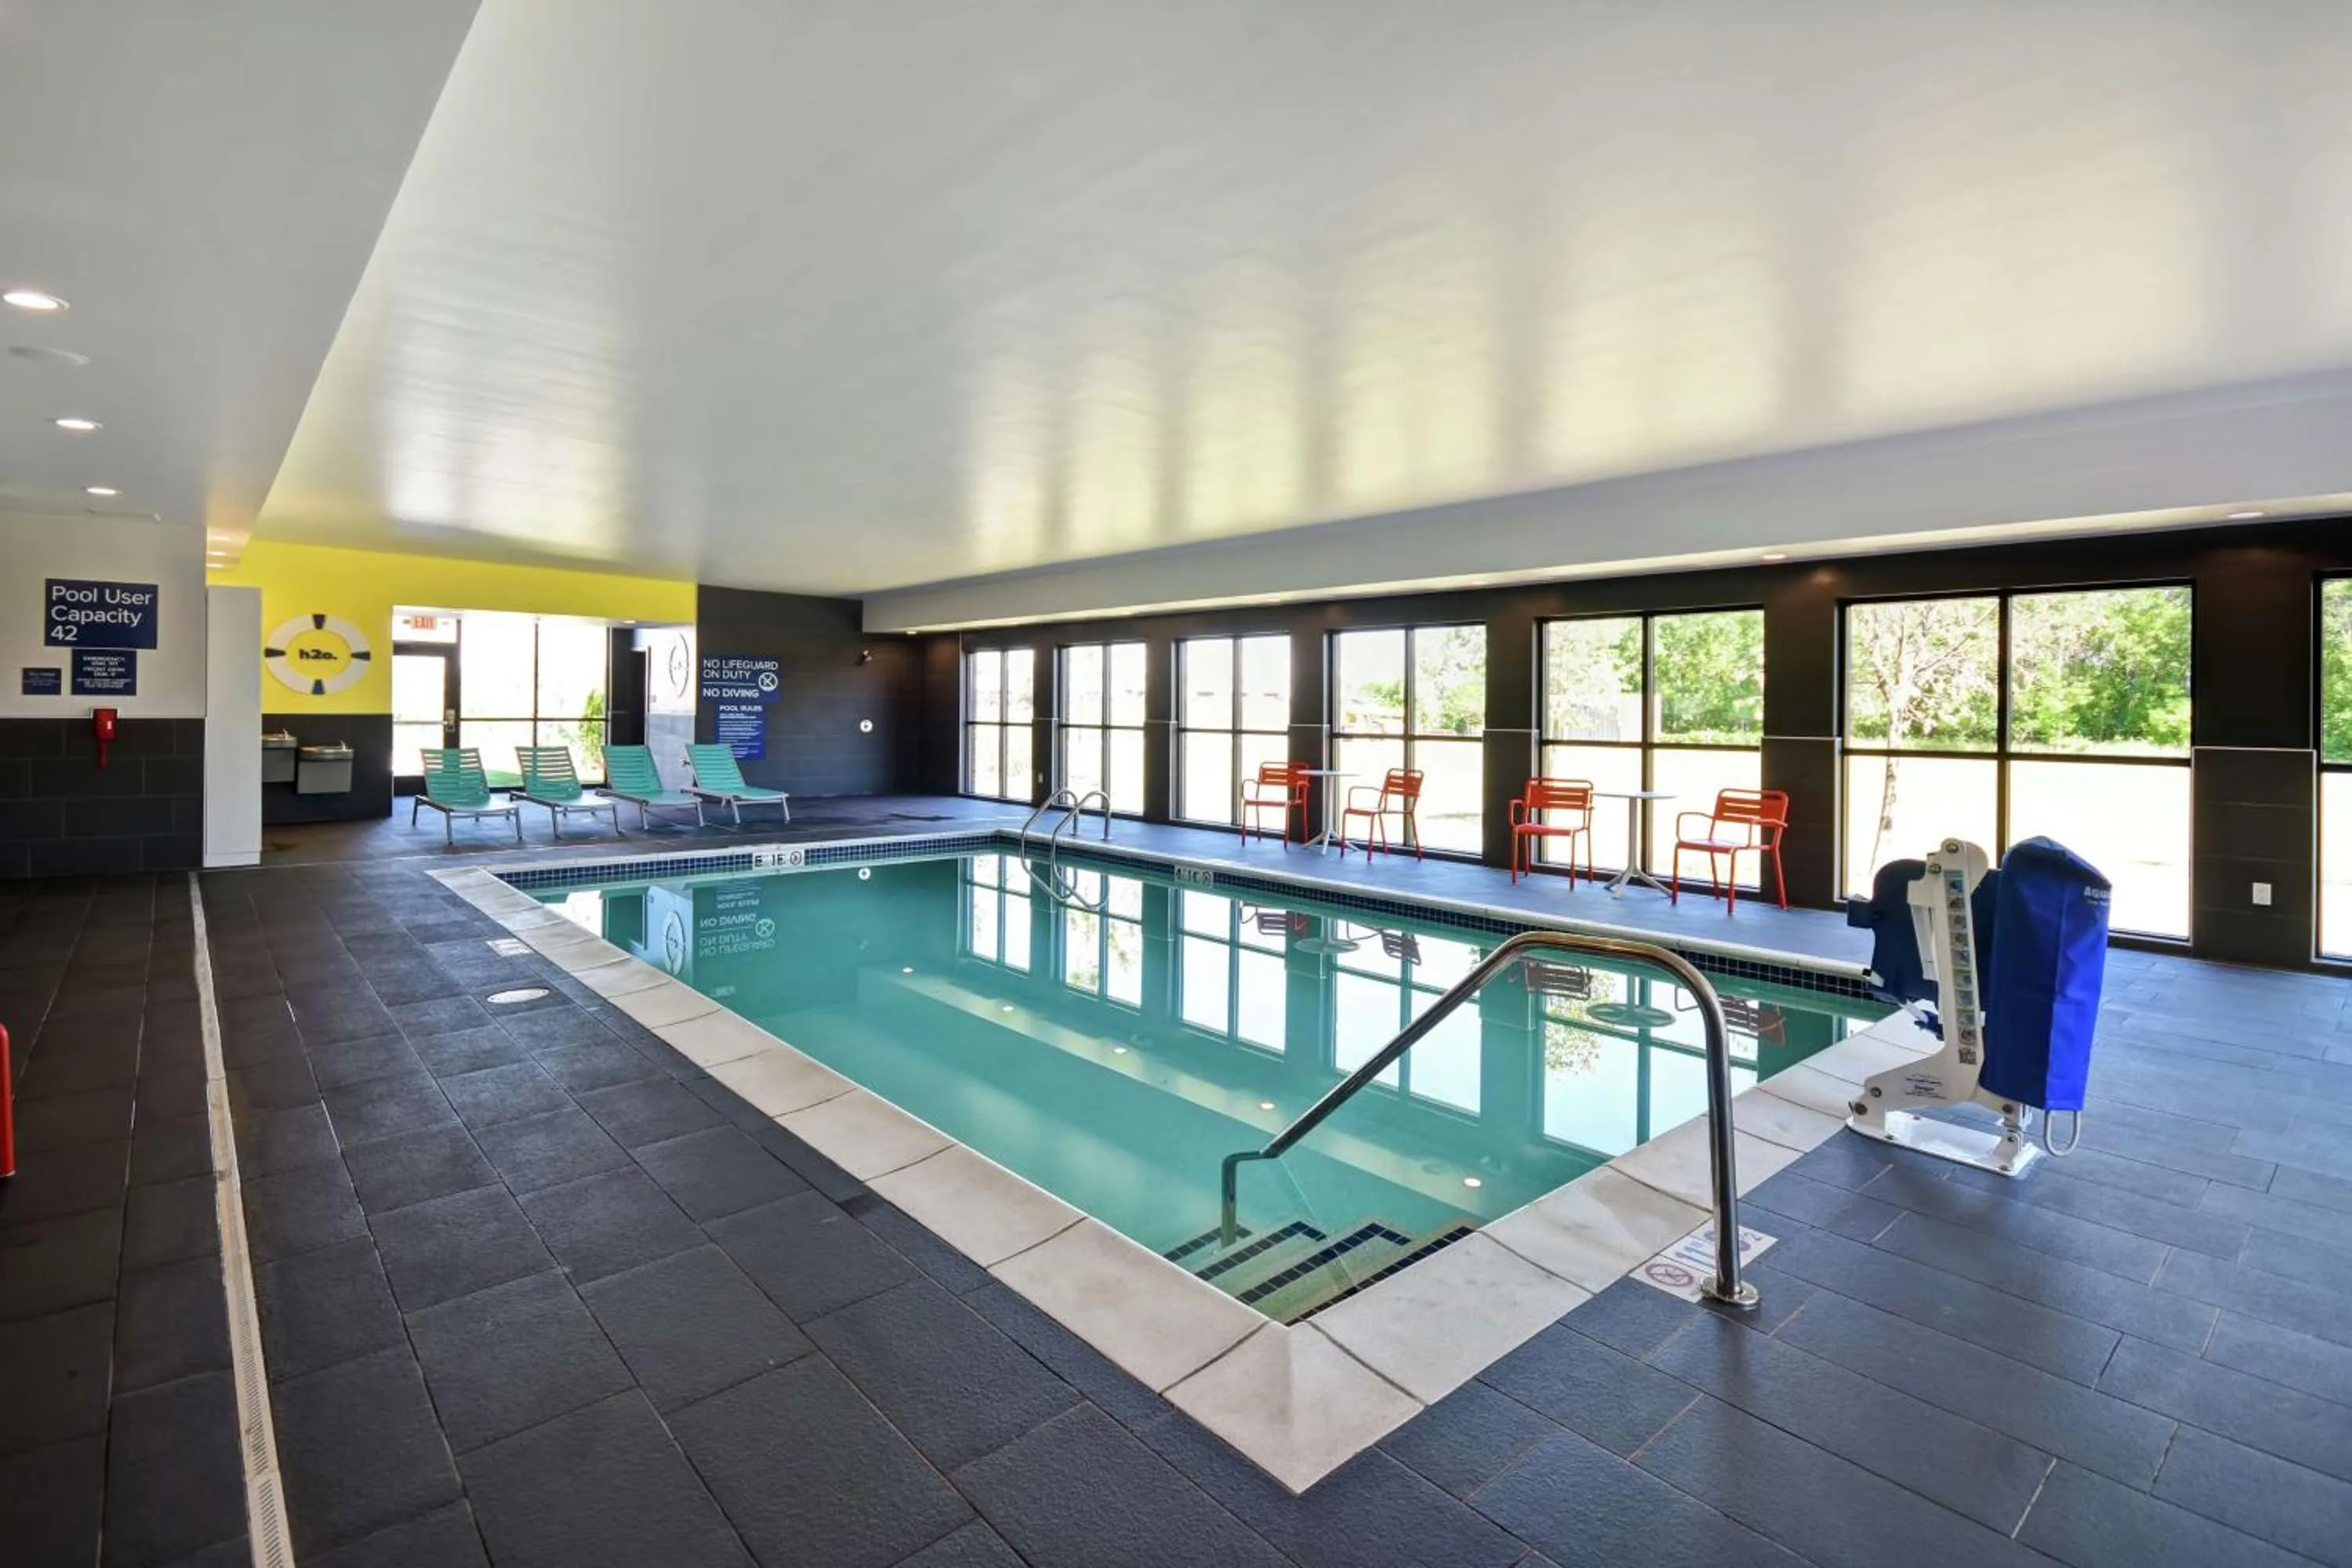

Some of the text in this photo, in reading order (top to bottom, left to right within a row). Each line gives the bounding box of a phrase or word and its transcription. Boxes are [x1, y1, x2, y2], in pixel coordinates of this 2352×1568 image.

[52, 586, 152, 605] Pool User
[51, 605, 142, 627] Capacity
[50, 625, 78, 641] 42
[702, 659, 779, 670] NO LIFEGUARD
[702, 670, 751, 680] ON DUTY
[702, 688, 760, 699] NO DIVING
